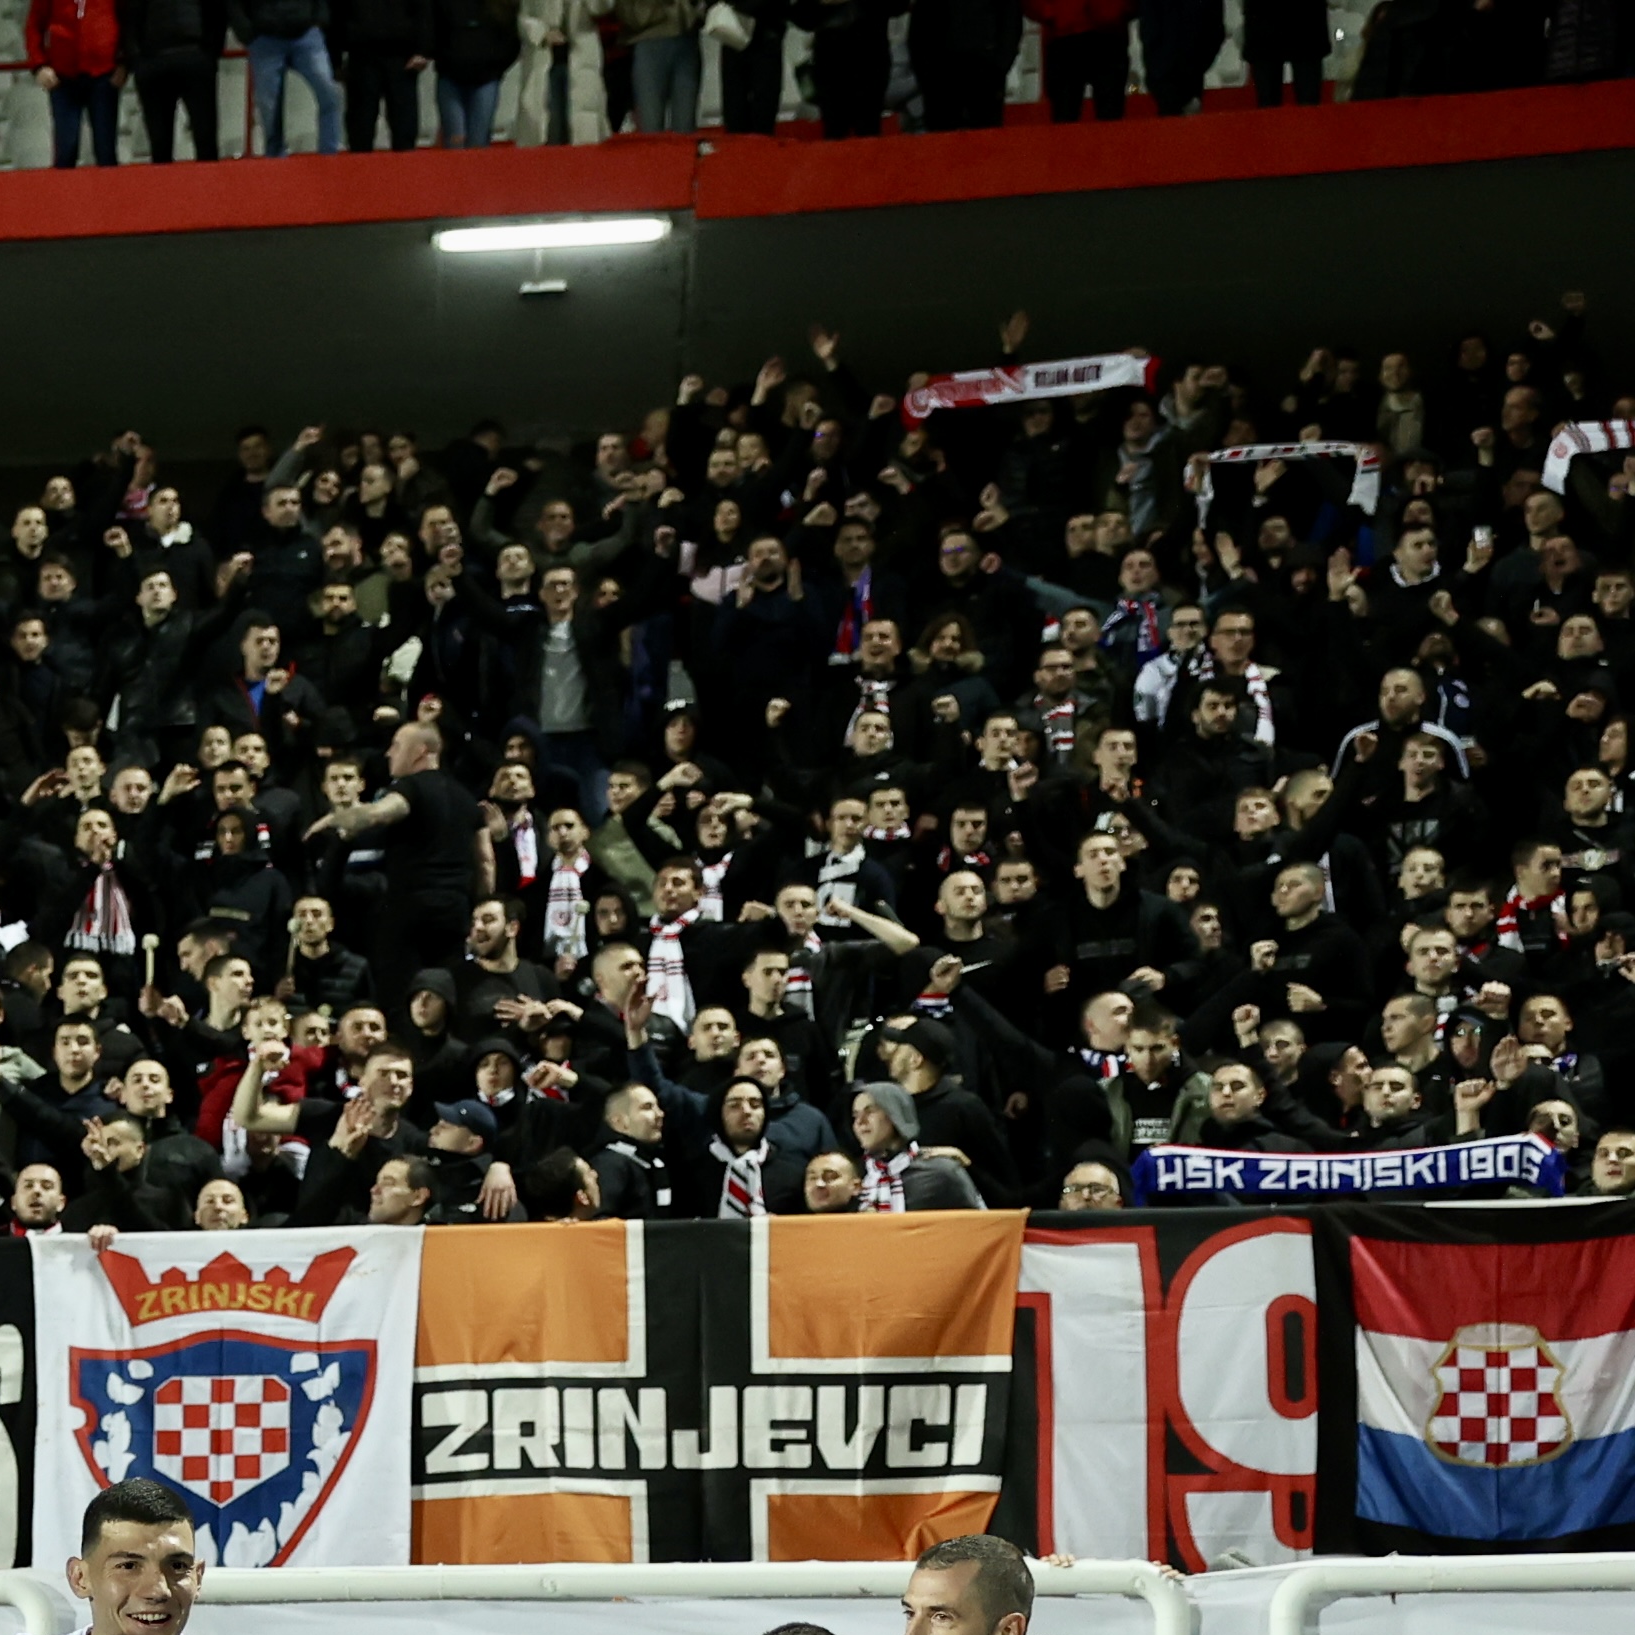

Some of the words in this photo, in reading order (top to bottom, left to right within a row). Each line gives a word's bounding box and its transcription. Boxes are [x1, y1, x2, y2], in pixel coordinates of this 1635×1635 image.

[1156, 1153, 1245, 1192] HŠK
[1259, 1150, 1448, 1192] ZRINJSKI
[1459, 1143, 1544, 1184] 1905
[134, 1281, 318, 1321] ZRINJSKI
[420, 1382, 988, 1475] ZRINJEVCI
